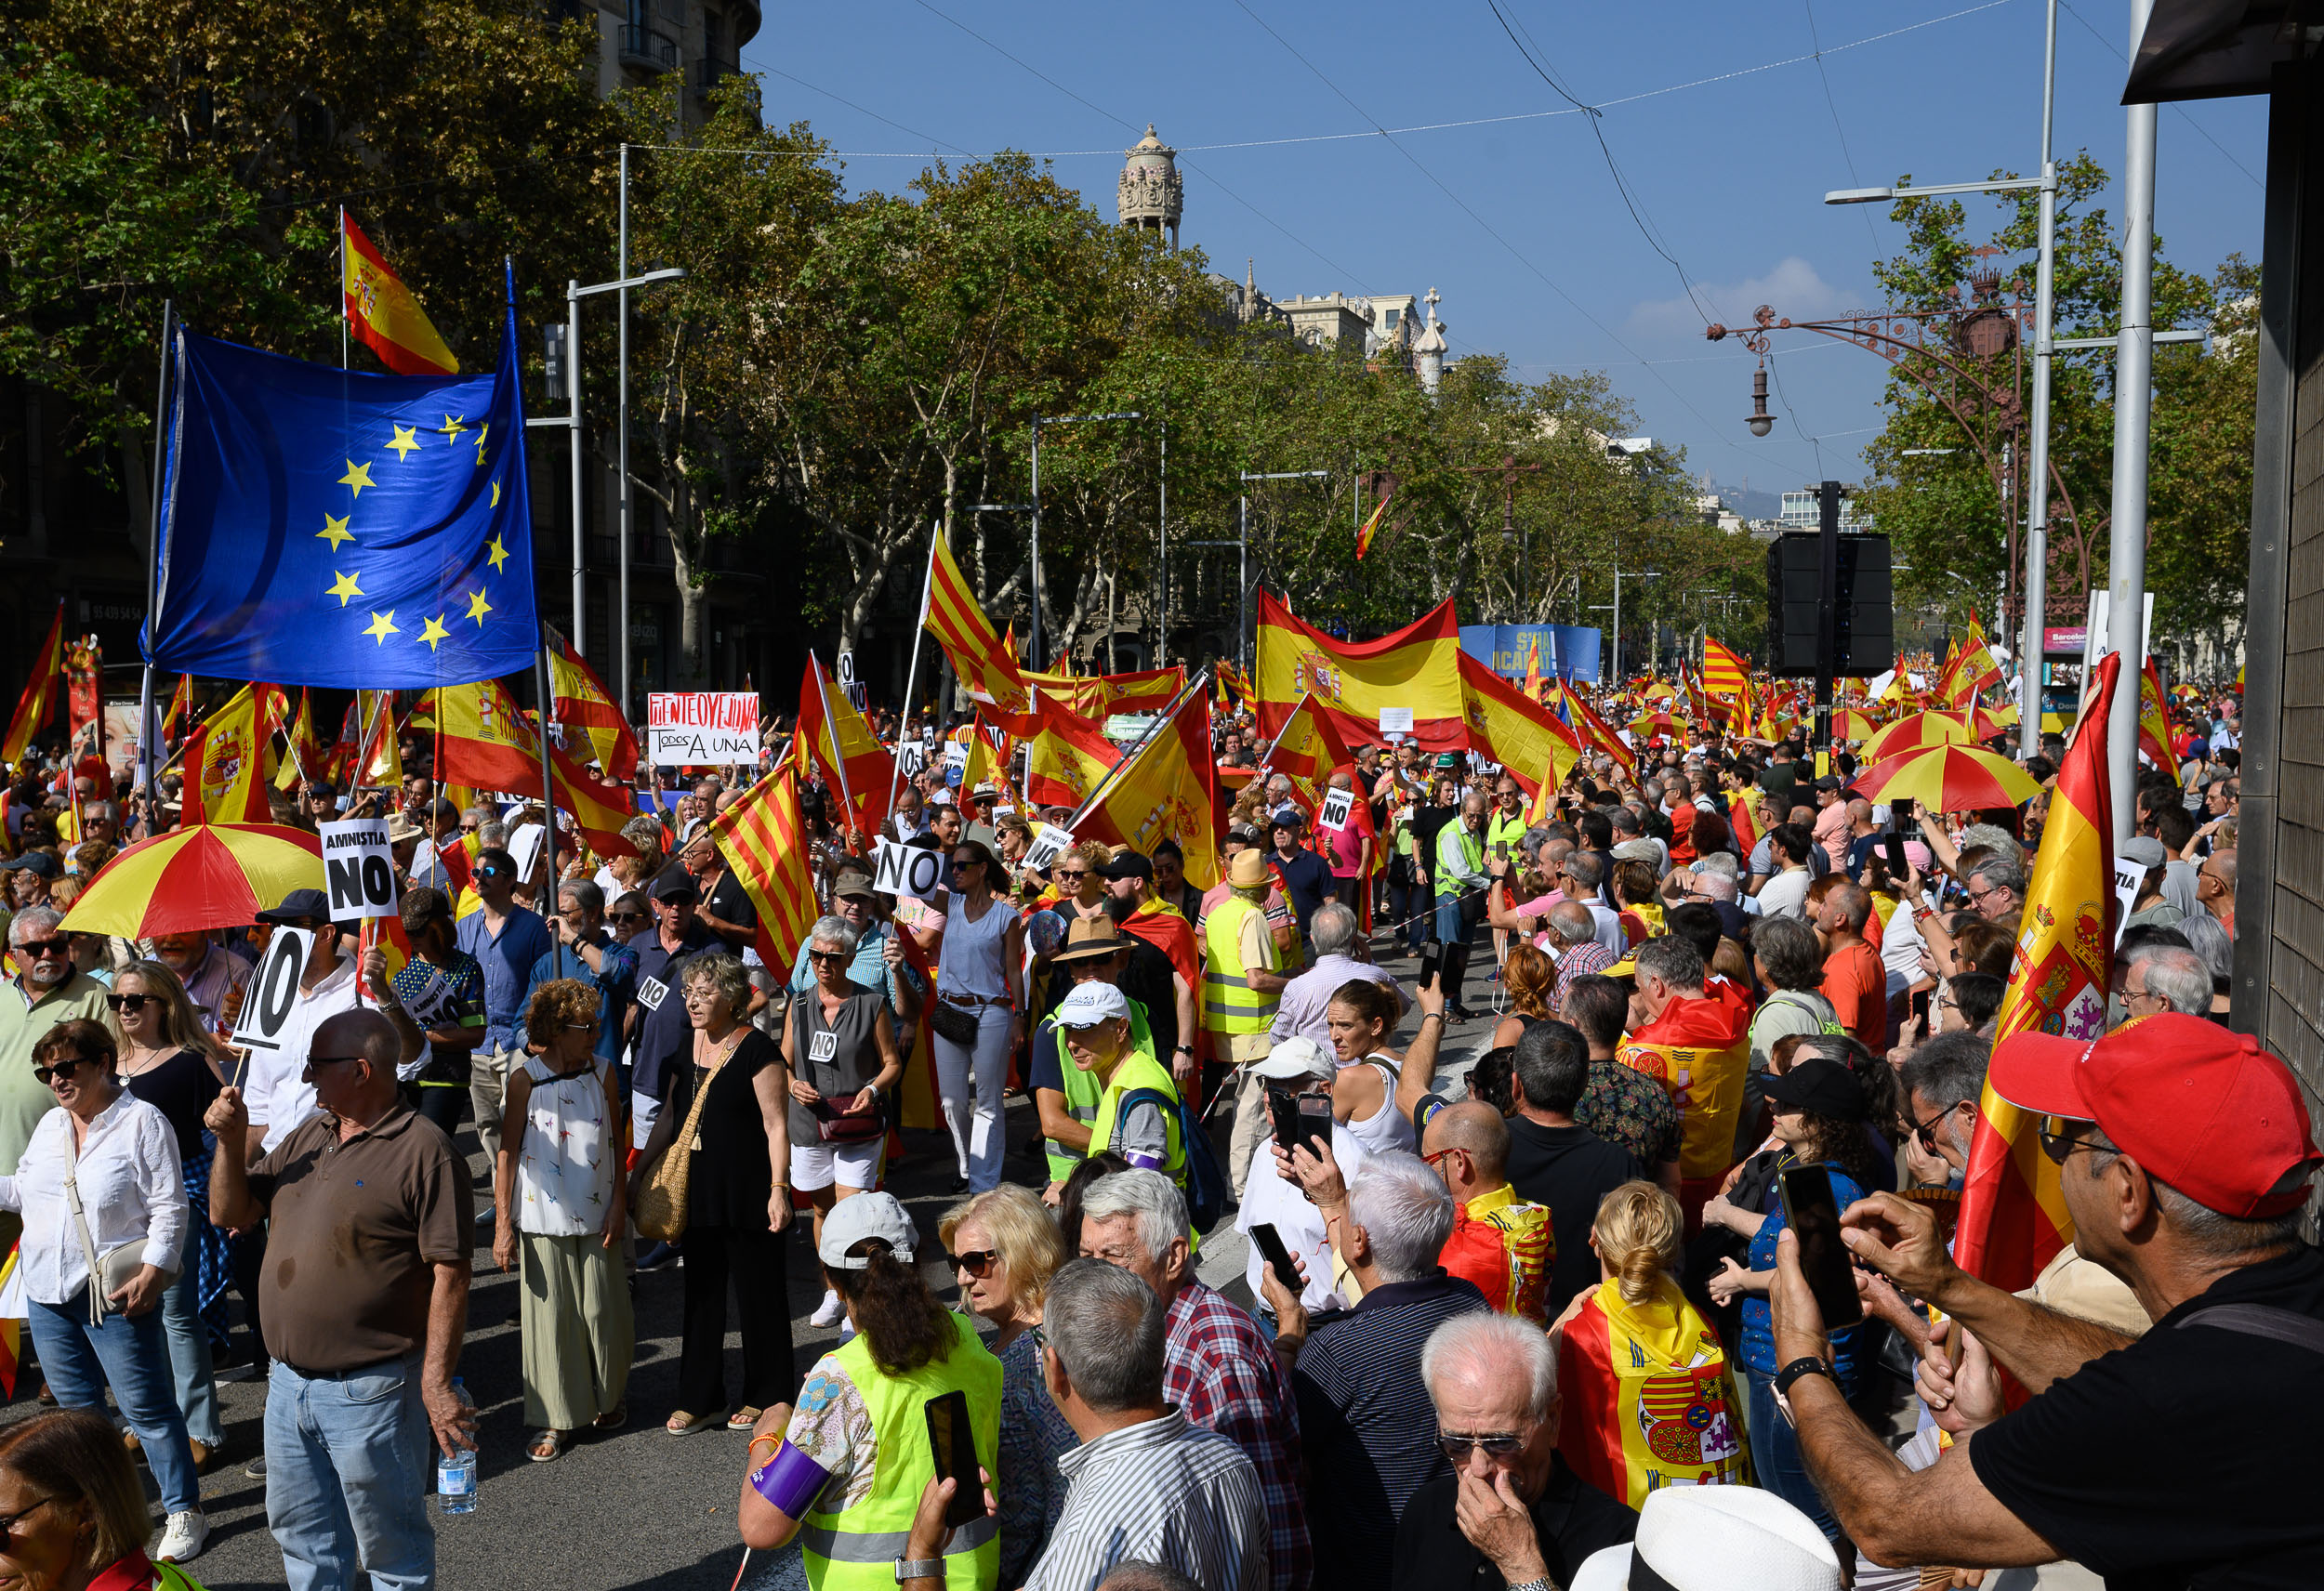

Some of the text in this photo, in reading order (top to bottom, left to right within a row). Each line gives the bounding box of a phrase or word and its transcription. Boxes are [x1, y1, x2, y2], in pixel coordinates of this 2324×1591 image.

[1516, 631, 1551, 651] S'HA
[687, 733, 708, 758] A
[712, 738, 754, 754] UNA
[1322, 801, 1347, 825] NO
[1024, 840, 1059, 868] NO
[877, 843, 940, 895] NO
[2115, 871, 2136, 891] TÍA
[327, 854, 391, 911] NO
[236, 930, 303, 1038] NO
[640, 979, 665, 1004] NO
[812, 1033, 835, 1057] NO
